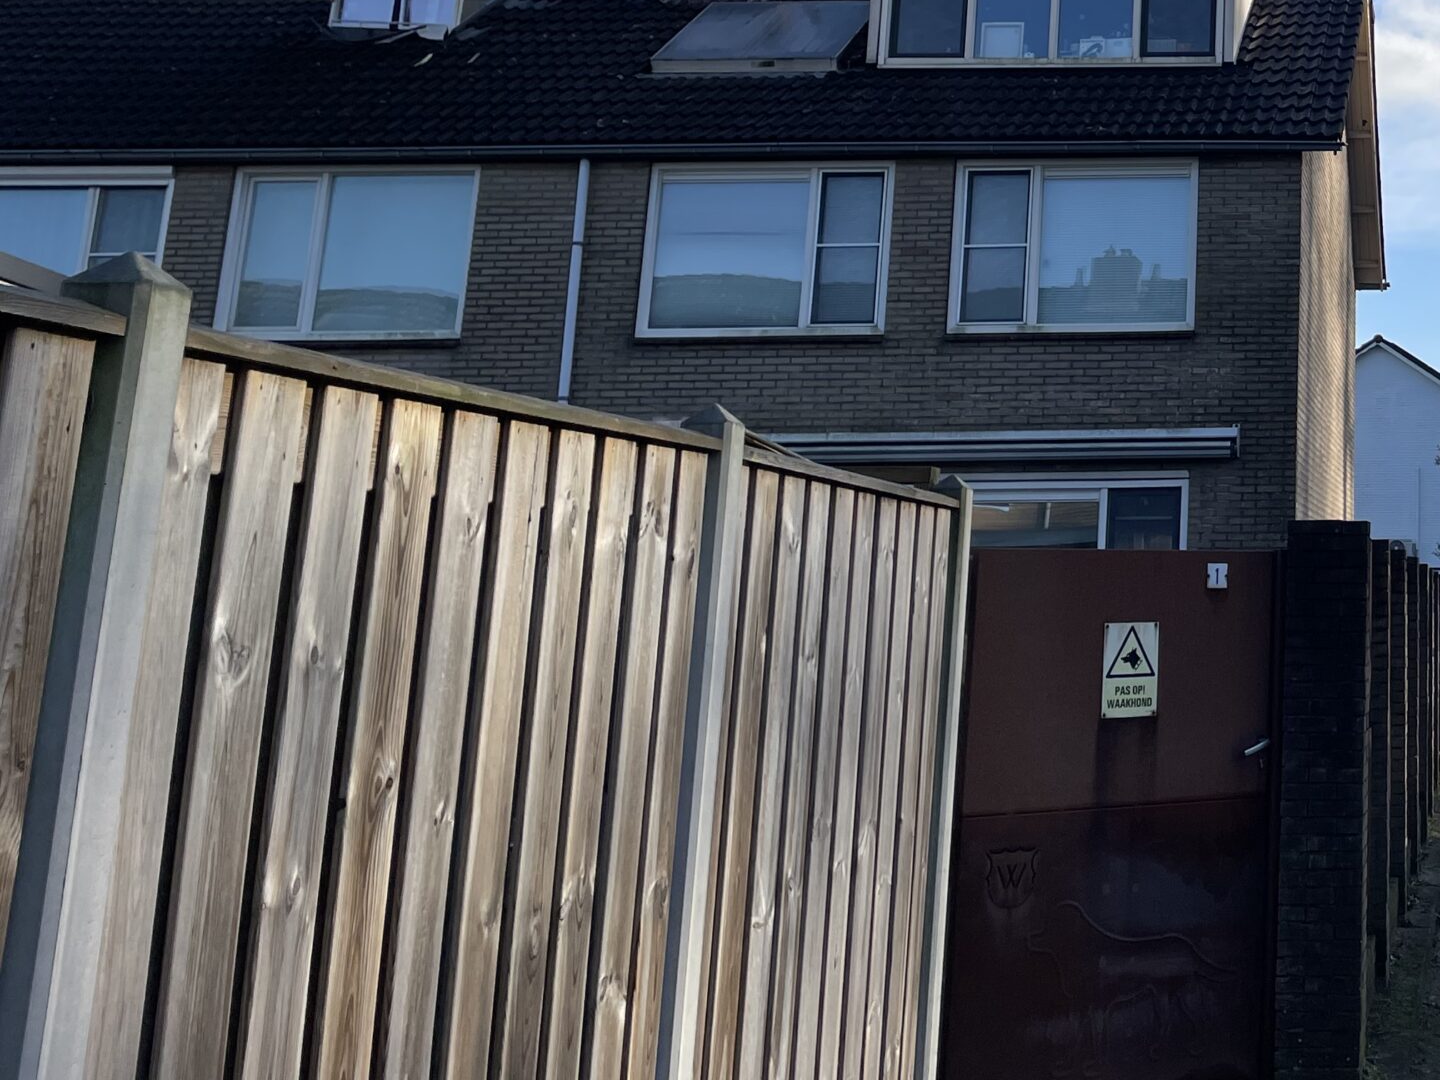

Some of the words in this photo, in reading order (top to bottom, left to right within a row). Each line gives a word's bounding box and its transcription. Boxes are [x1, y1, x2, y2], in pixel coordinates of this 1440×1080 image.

[1215, 567, 1220, 585] 1
[1114, 685, 1131, 696] PAS
[1106, 697, 1153, 709] WAAKHOND
